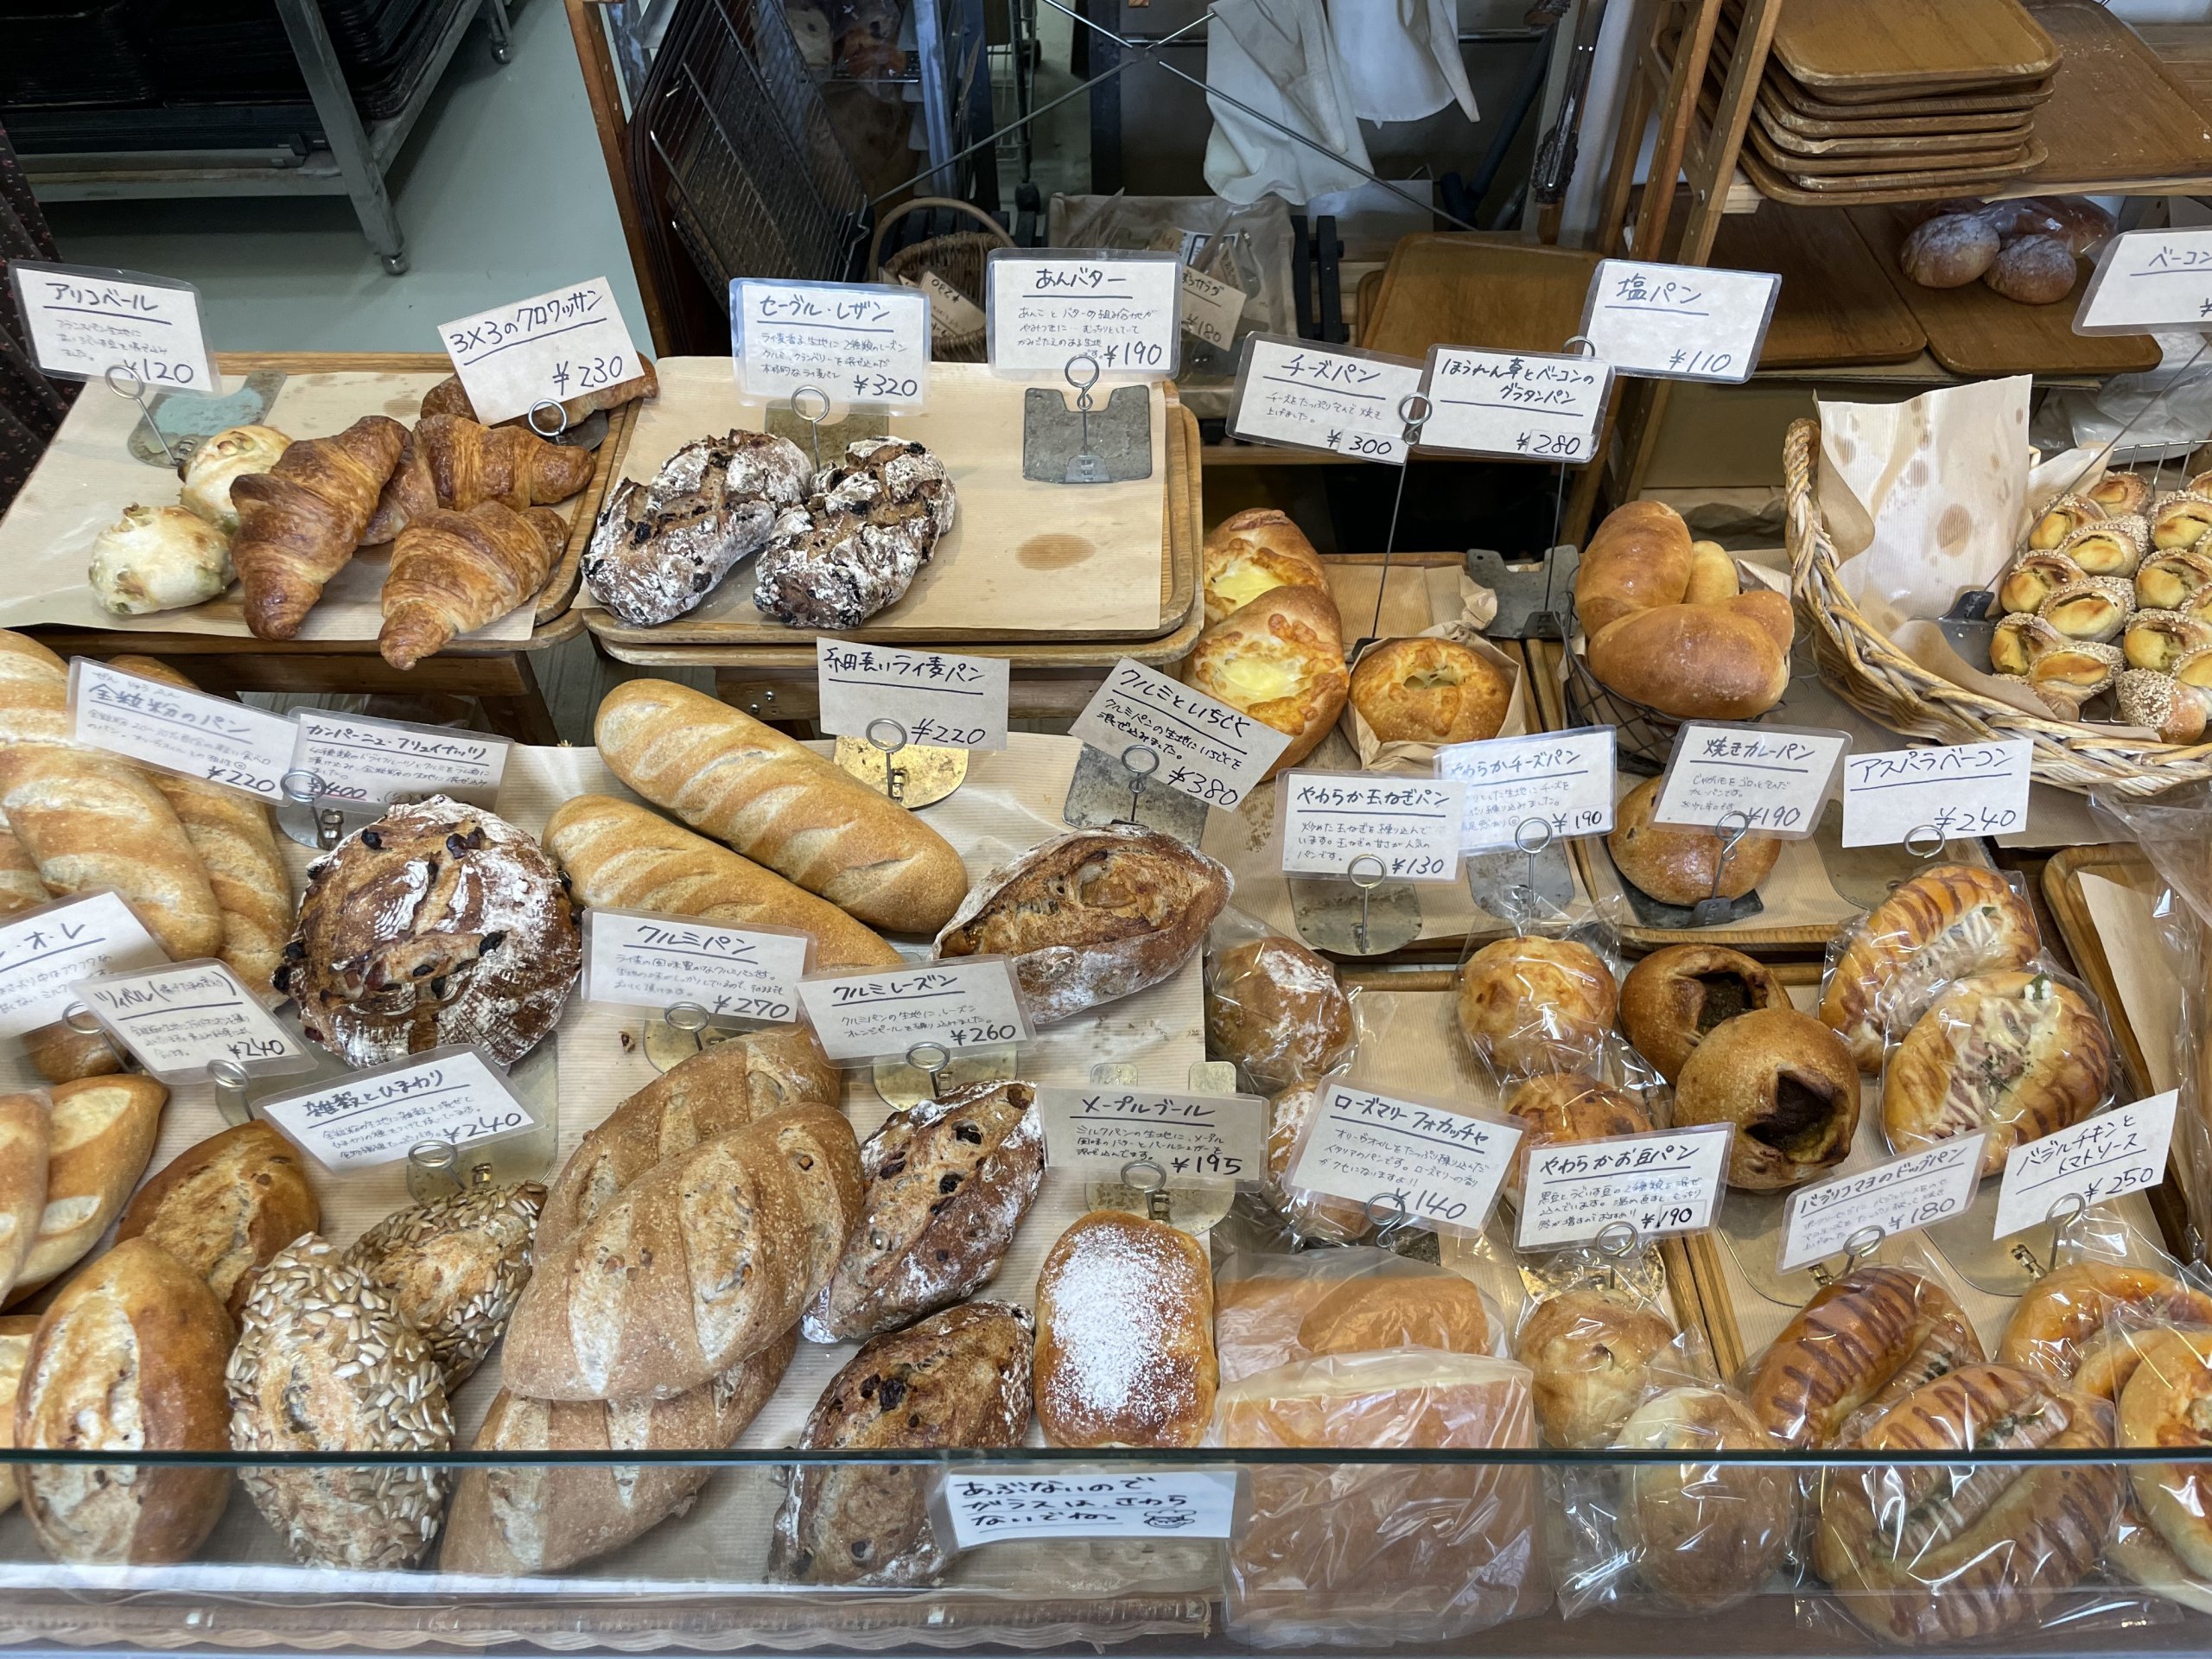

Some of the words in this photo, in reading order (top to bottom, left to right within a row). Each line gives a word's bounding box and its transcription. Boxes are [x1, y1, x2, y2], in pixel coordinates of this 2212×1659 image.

[1034, 265, 1127, 289] あんバター
[1616, 272, 1702, 306] 塩パン
[43, 282, 159, 311] アリコベール
[1103, 341, 1162, 367] ¥190
[1669, 349, 1732, 373] ¥110
[123, 358, 194, 384] ¥120
[552, 355, 623, 396] ¥230
[1281, 353, 1381, 384] チーズパン
[1440, 357, 1594, 385] ほうれん草とベーコンの
[852, 372, 918, 397] ¥320
[1500, 385, 1576, 404] グラタンパン
[1326, 429, 1392, 454] ¥300
[1516, 432, 1581, 455] ¥280
[823, 646, 985, 683] 細長いライ麦パン
[87, 683, 251, 733] 全粒粉のパン
[911, 718, 986, 745] ¥220
[1702, 736, 1815, 760] 焼きカレーパン
[1452, 749, 1581, 777] やわらかチーズパン
[1850, 747, 2014, 783] アスパラベーコン
[207, 766, 276, 792] ¥220
[1168, 766, 1238, 805] ¥380
[1297, 786, 1450, 808] やわらか玉ねぎパン
[1552, 810, 1602, 834] ¥190
[1747, 806, 1801, 827] ¥190
[1934, 807, 2017, 835] ¥240
[1392, 856, 1445, 874] ¥130
[0, 923, 86, 958] ・オ・レ
[637, 925, 756, 955] クルミパン
[832, 975, 958, 1001] クルミレーズン
[713, 995, 790, 1018] ¥270
[227, 1038, 285, 1059] ¥240
[950, 1025, 1016, 1046] ¥260
[302, 1070, 443, 1117] 雑穀とひまわり
[1082, 1095, 1216, 1116] メープルブール
[443, 1113, 522, 1143] ¥240
[1335, 1094, 1490, 1146] ローズマリーフォカッチャ
[1171, 1154, 1243, 1175] ¥195
[1540, 1145, 1700, 1176] やわらかお豆パン
[2059, 1133, 2138, 1174] トマトソース
[2084, 1167, 2153, 1202] ¥250
[1392, 1188, 1467, 1219] ¥140
[1889, 1198, 1955, 1230] ¥180
[1642, 1208, 1693, 1229] ¥190
[954, 1477, 1156, 1496] あぶないので
[971, 1511, 1116, 1526] ないでね。
